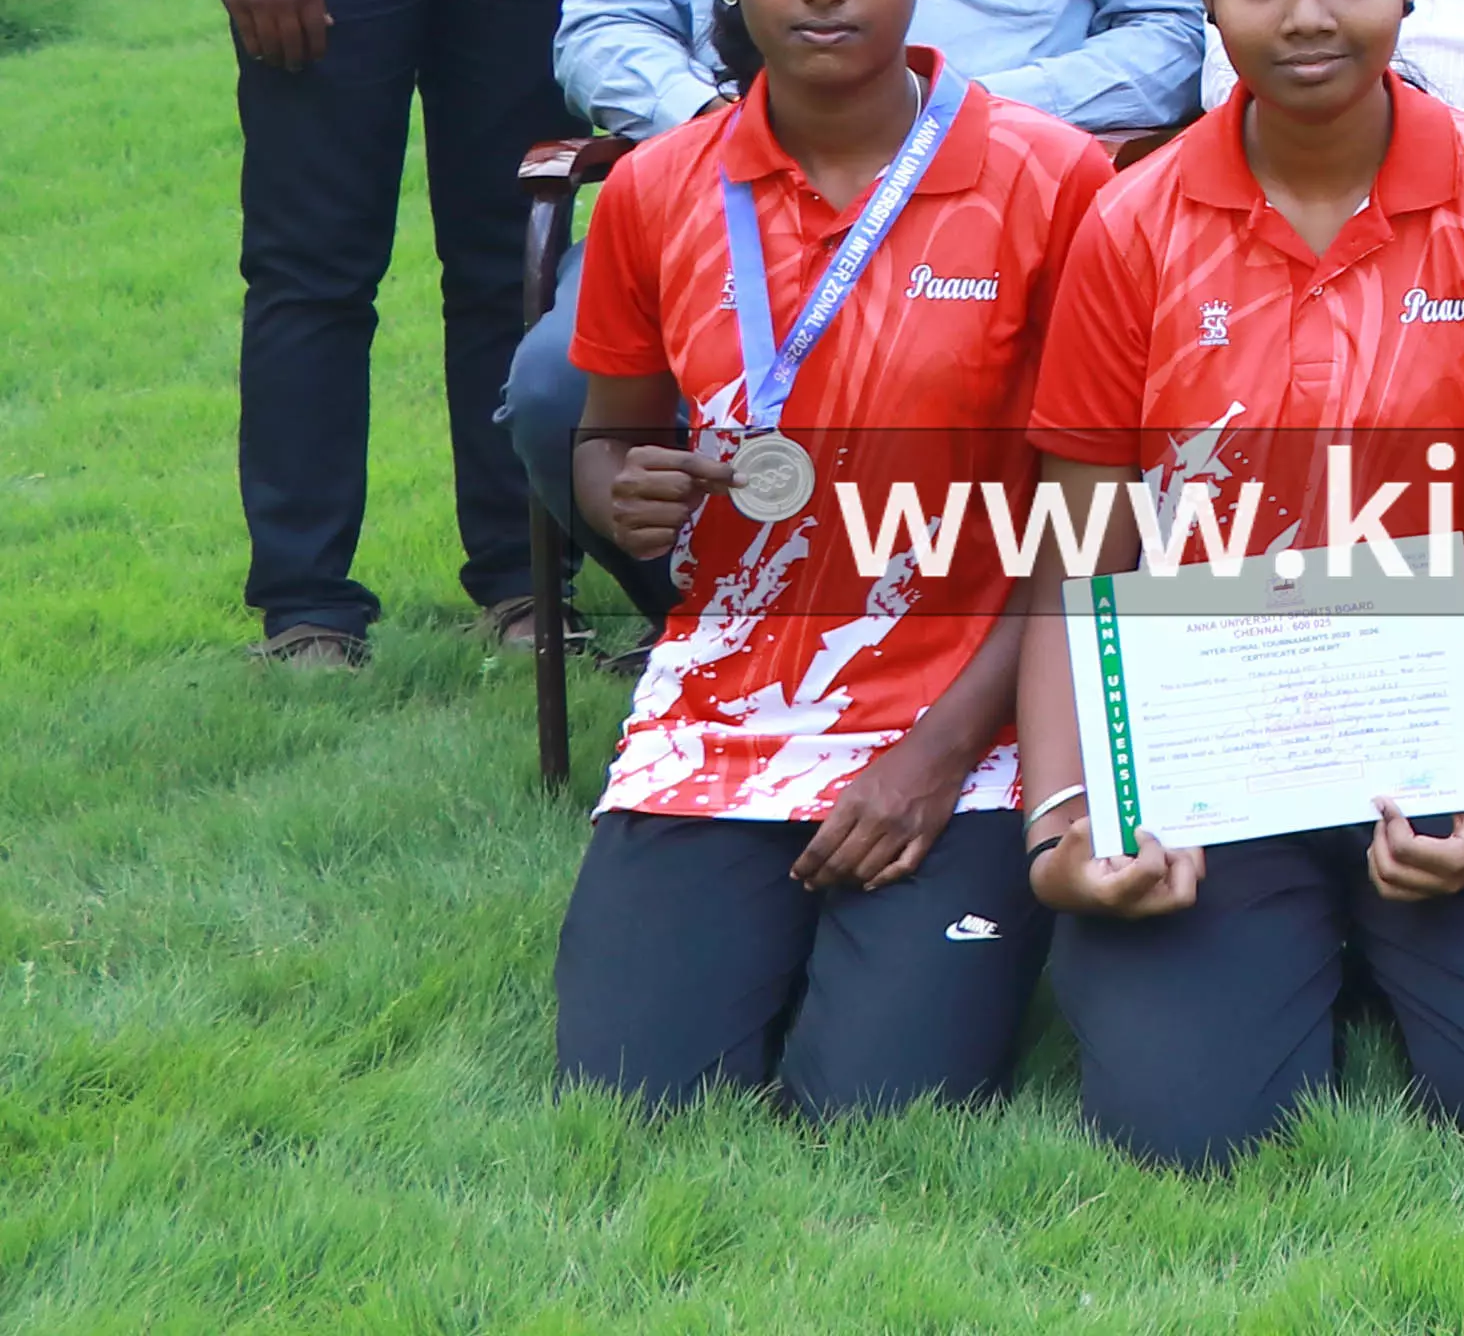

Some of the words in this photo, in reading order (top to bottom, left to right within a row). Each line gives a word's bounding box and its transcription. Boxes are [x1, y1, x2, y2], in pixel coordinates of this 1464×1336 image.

[907, 114, 941, 158] ANNA
[861, 156, 922, 244] UNIVERSITY
[832, 238, 869, 284] INTER
[905, 264, 1000, 301] Paavai
[807, 277, 844, 332] ZONAL
[1097, 597, 1117, 657] ANNA
[1186, 622, 1218, 633] ANNA
[1219, 615, 1284, 631] UNIVERSITY
[1334, 600, 1375, 614] BOARD
[1233, 625, 1283, 639] CHENNAI
[1106, 675, 1136, 827] UNIVERSITY
